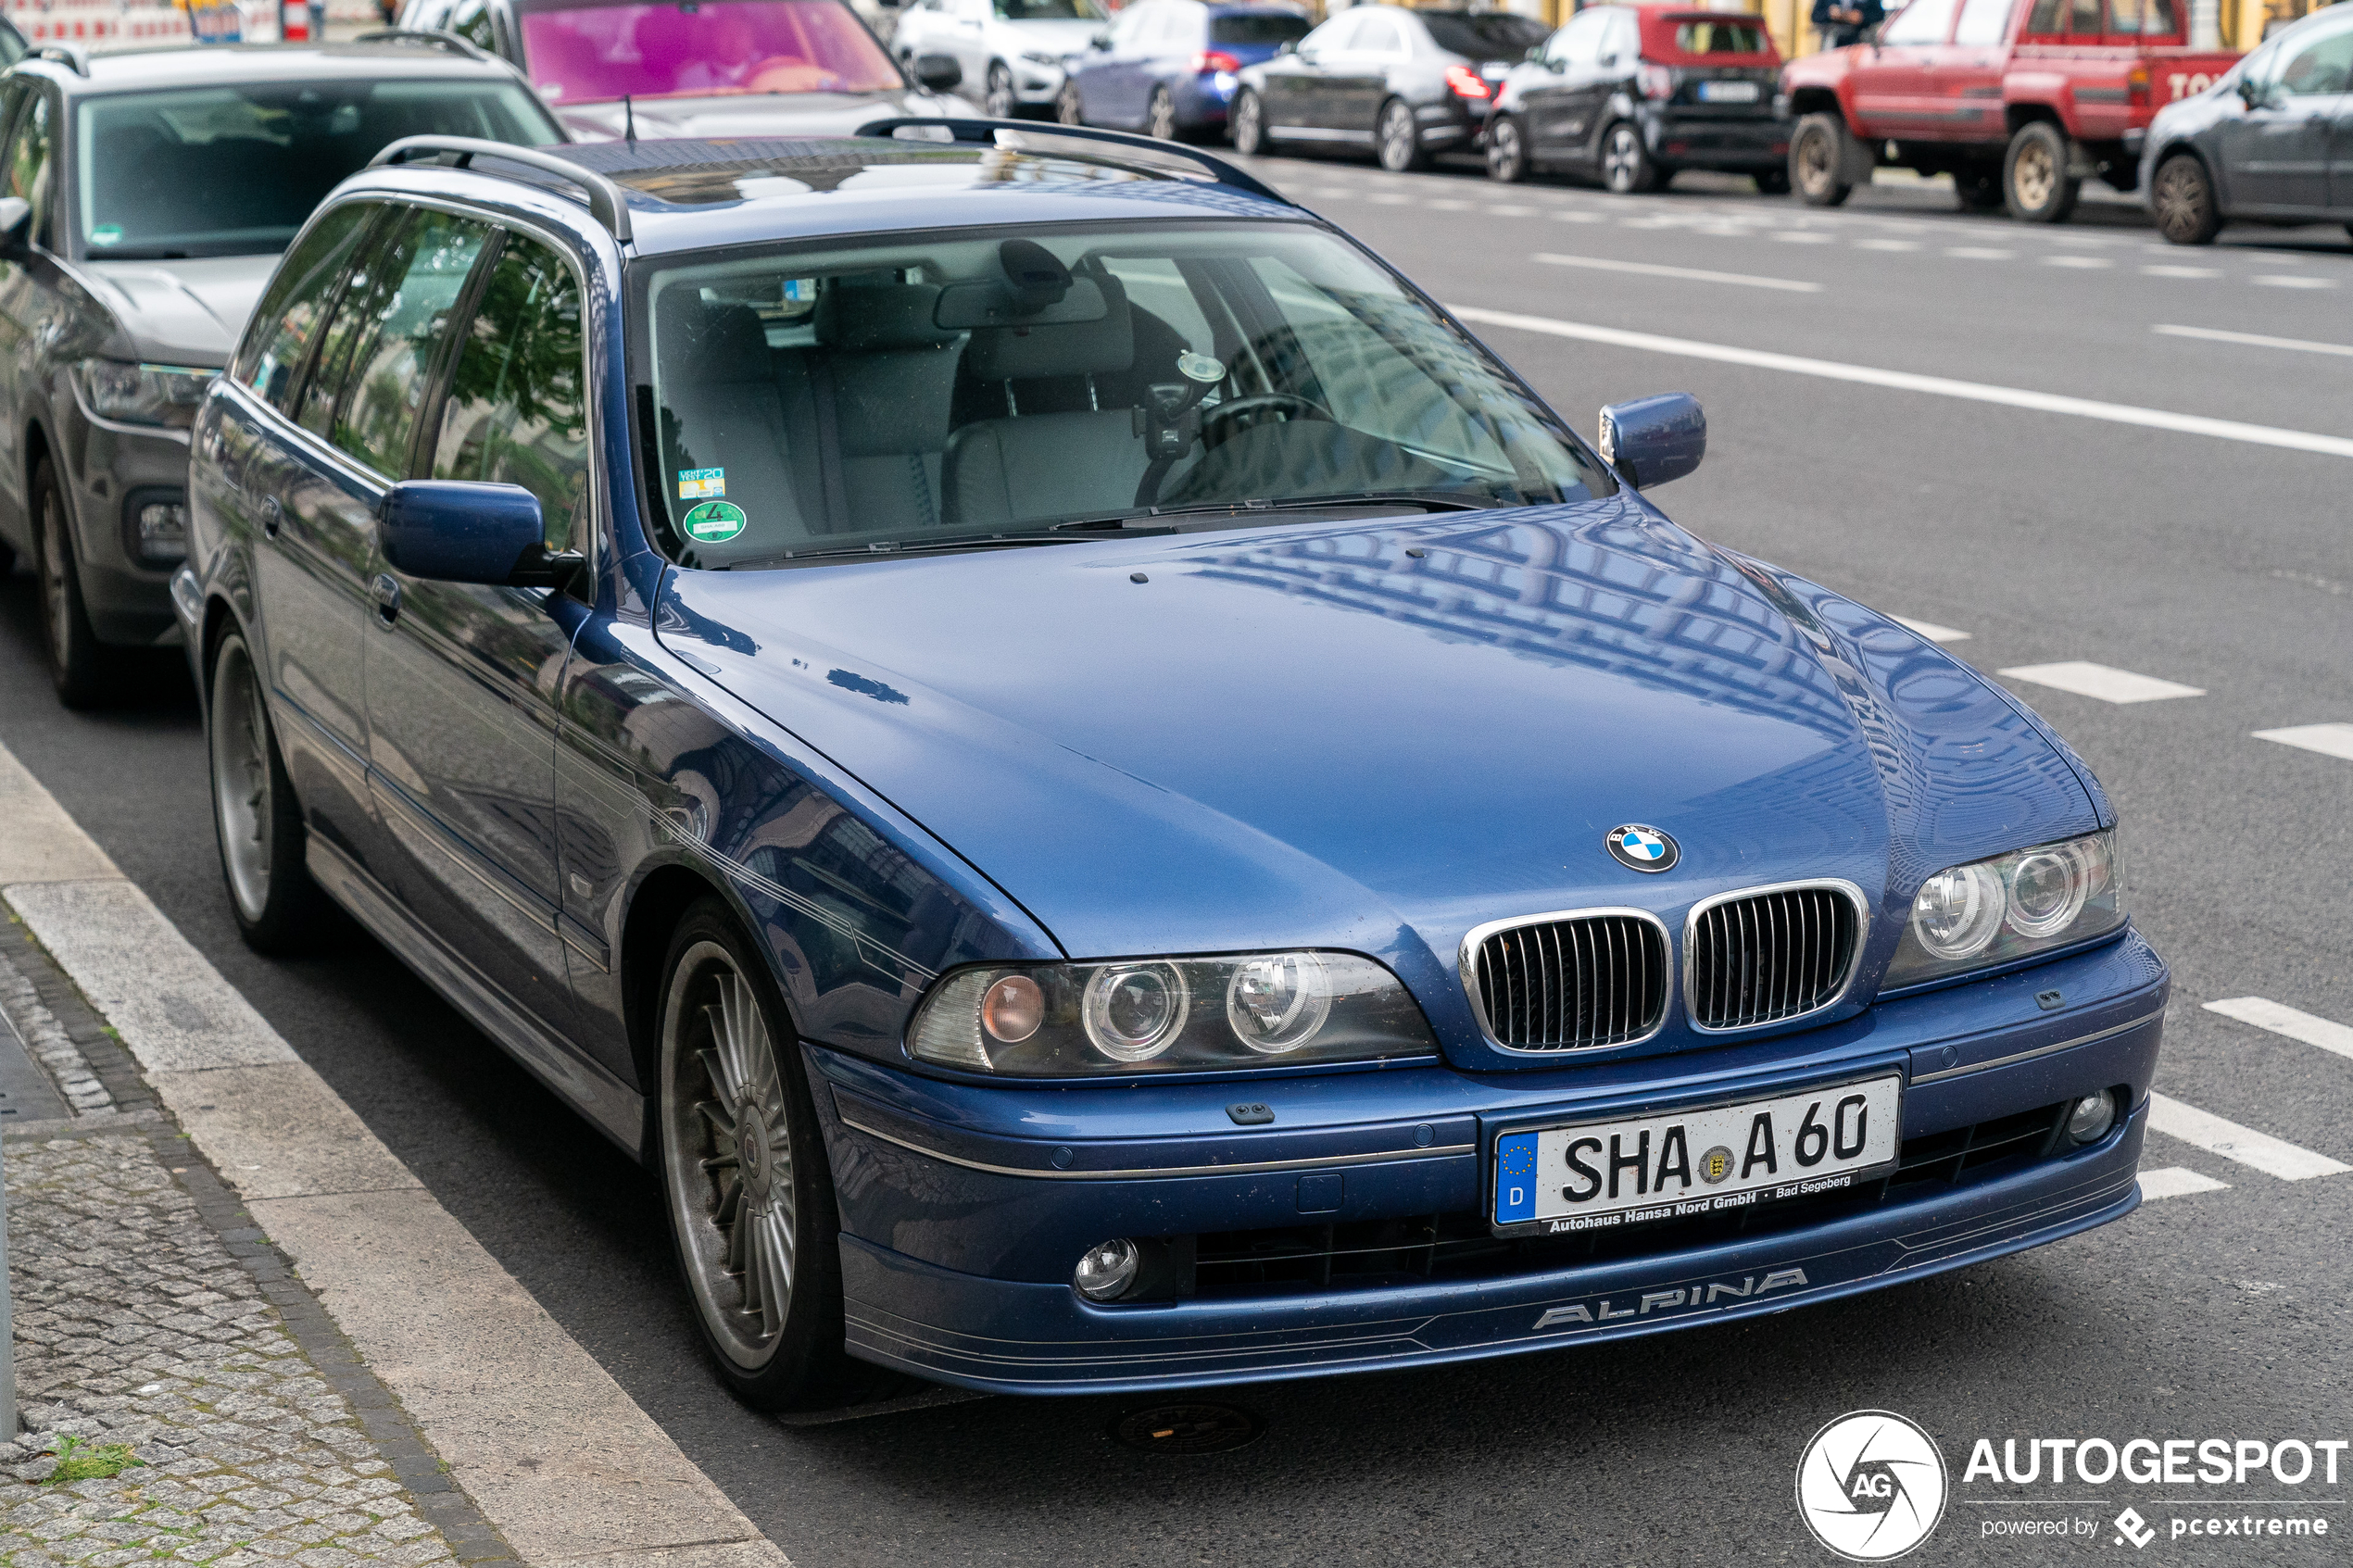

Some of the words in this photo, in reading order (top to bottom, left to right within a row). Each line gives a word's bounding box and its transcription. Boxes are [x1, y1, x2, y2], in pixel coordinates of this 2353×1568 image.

[2167, 72, 2221, 102] TO
[706, 504, 724, 521] 4
[1610, 826, 1662, 842] BMW
[1562, 1124, 1692, 1202] SHA
[1509, 1186, 1524, 1206] D
[1550, 1214, 1621, 1233] Autohaus
[1625, 1207, 1671, 1223] Hansa
[1676, 1200, 1710, 1214] Nord
[1714, 1192, 1756, 1210] GmbH
[1776, 1184, 1798, 1199] Bad
[1800, 1175, 1851, 1195] Segeberg
[1532, 1268, 1809, 1330] ALPINA
